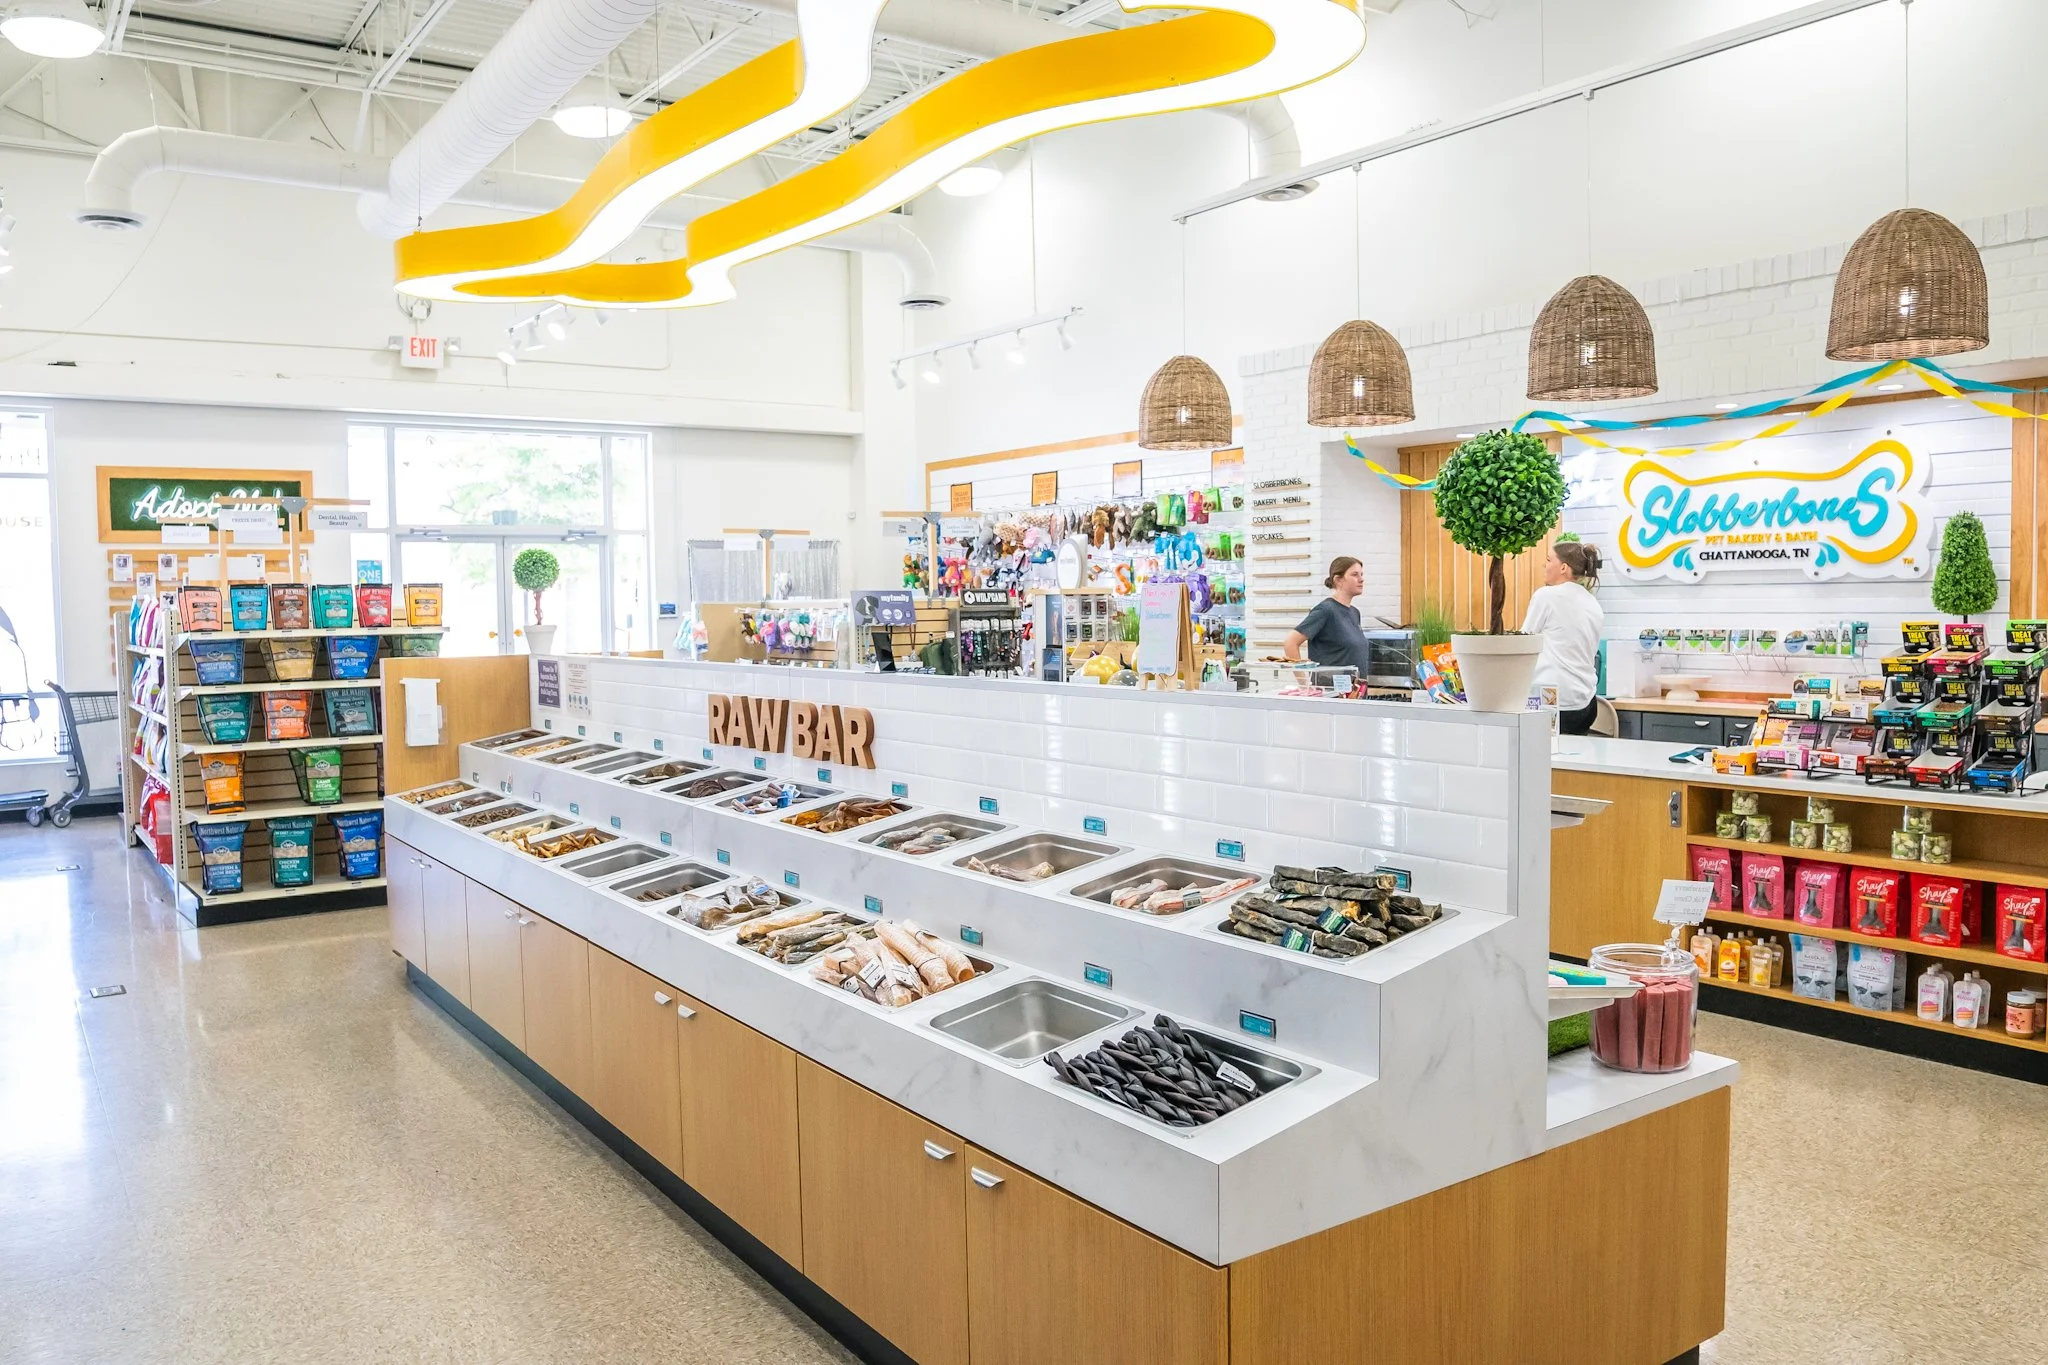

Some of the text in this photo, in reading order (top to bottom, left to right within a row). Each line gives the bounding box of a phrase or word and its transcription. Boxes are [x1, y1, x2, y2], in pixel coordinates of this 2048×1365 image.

[410, 337, 437, 358] EXIT
[1253, 478, 1302, 489] SLOBBERBONES
[132, 486, 222, 521] Adopt
[1254, 496, 1301, 507] BAKERY MENU
[1253, 515, 1282, 523] COOKIES
[1705, 531, 1818, 546] PET BAKERY & BATH
[1699, 548, 1810, 561] CHATTANOOGA, TN
[358, 570, 381, 578] ONE
[881, 594, 909, 602] myfamily
[975, 592, 1007, 603] WOLFGANG
[2012, 631, 2032, 639] TREAT
[708, 694, 876, 769] RAW BAR
[1919, 887, 1953, 903] Shay's
[2003, 898, 2037, 914] Shay's
